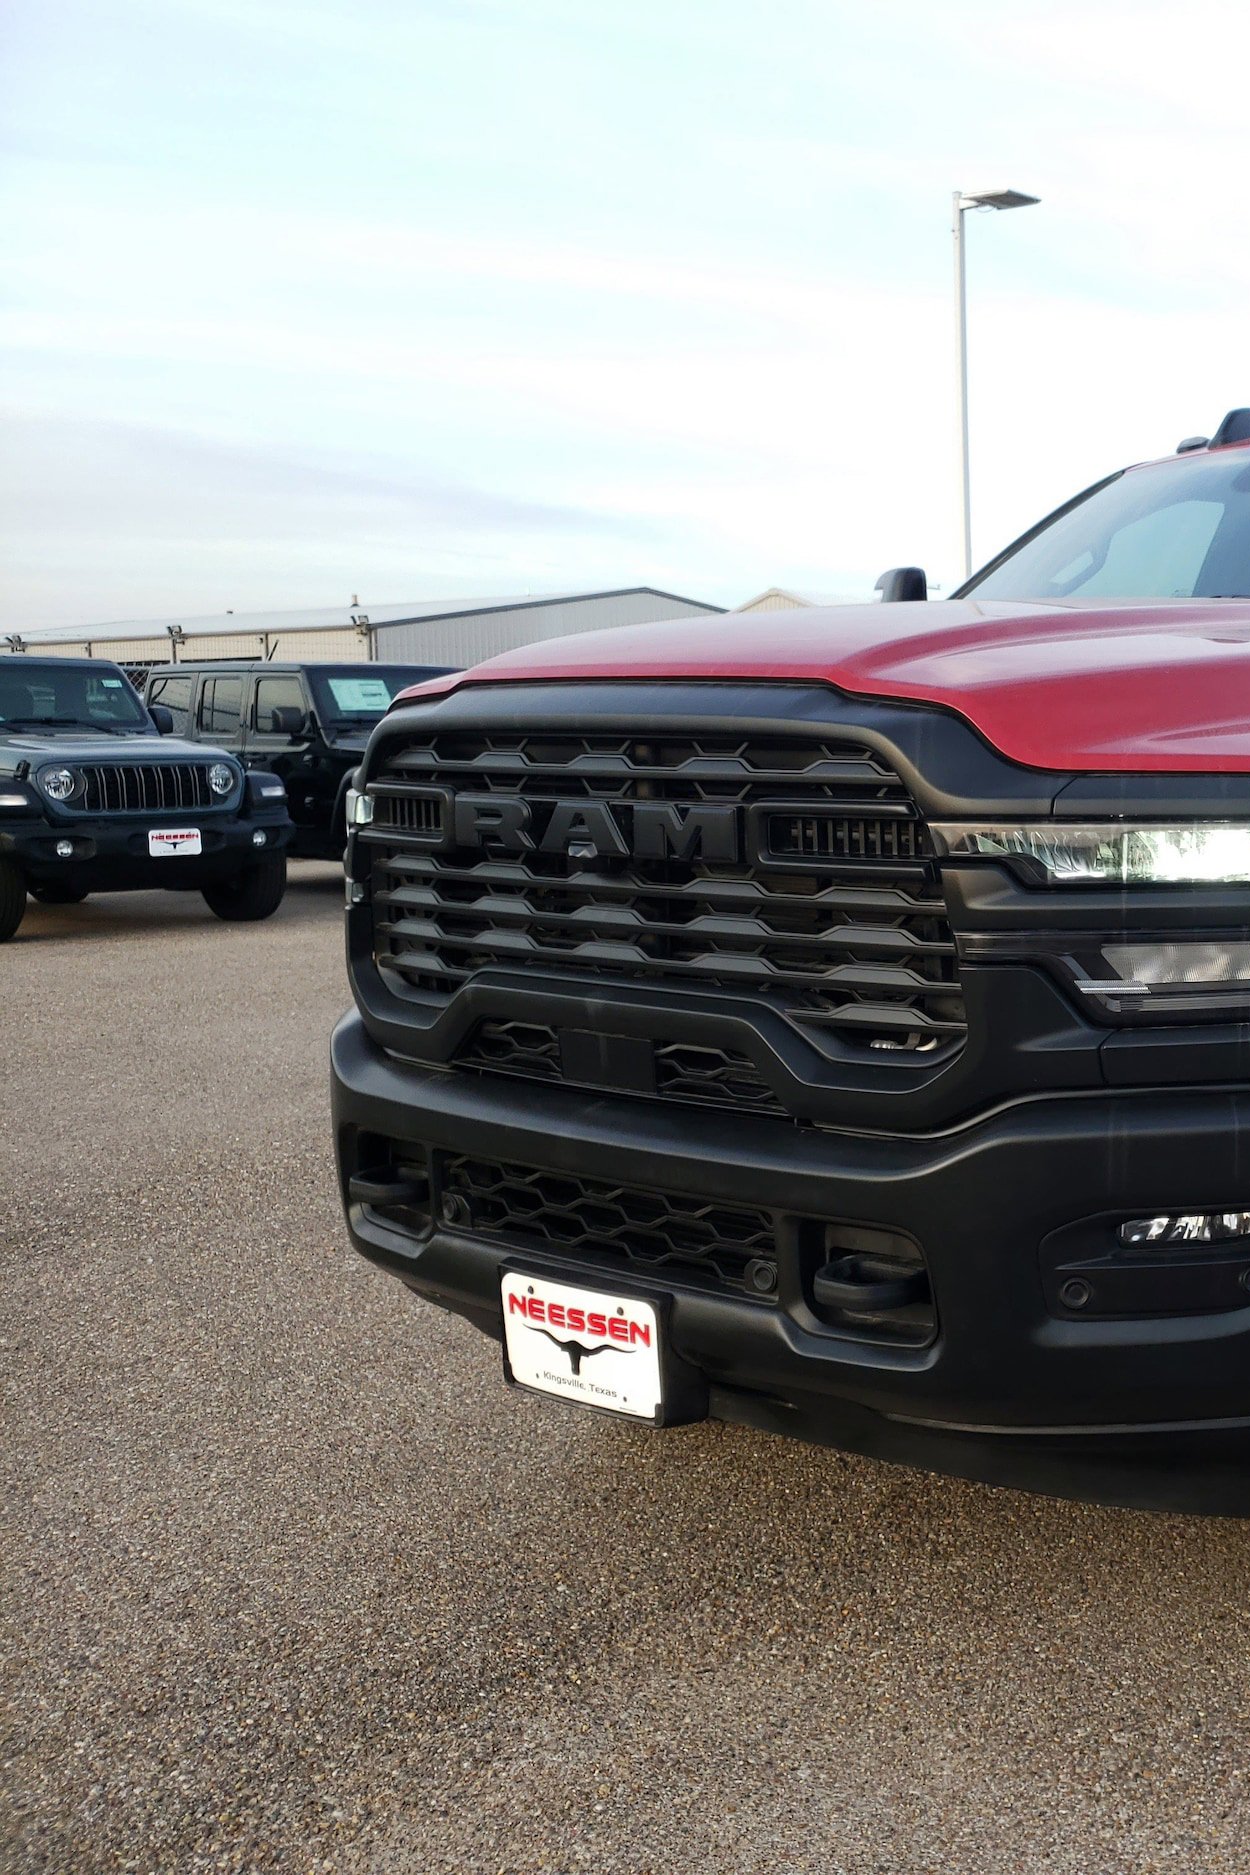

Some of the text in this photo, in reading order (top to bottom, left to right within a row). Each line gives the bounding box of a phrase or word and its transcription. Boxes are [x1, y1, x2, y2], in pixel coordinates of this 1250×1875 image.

[454, 795, 738, 860] RAM
[508, 1292, 651, 1348] NEESSEN
[543, 1370, 617, 1397] Kingsville, Texas
